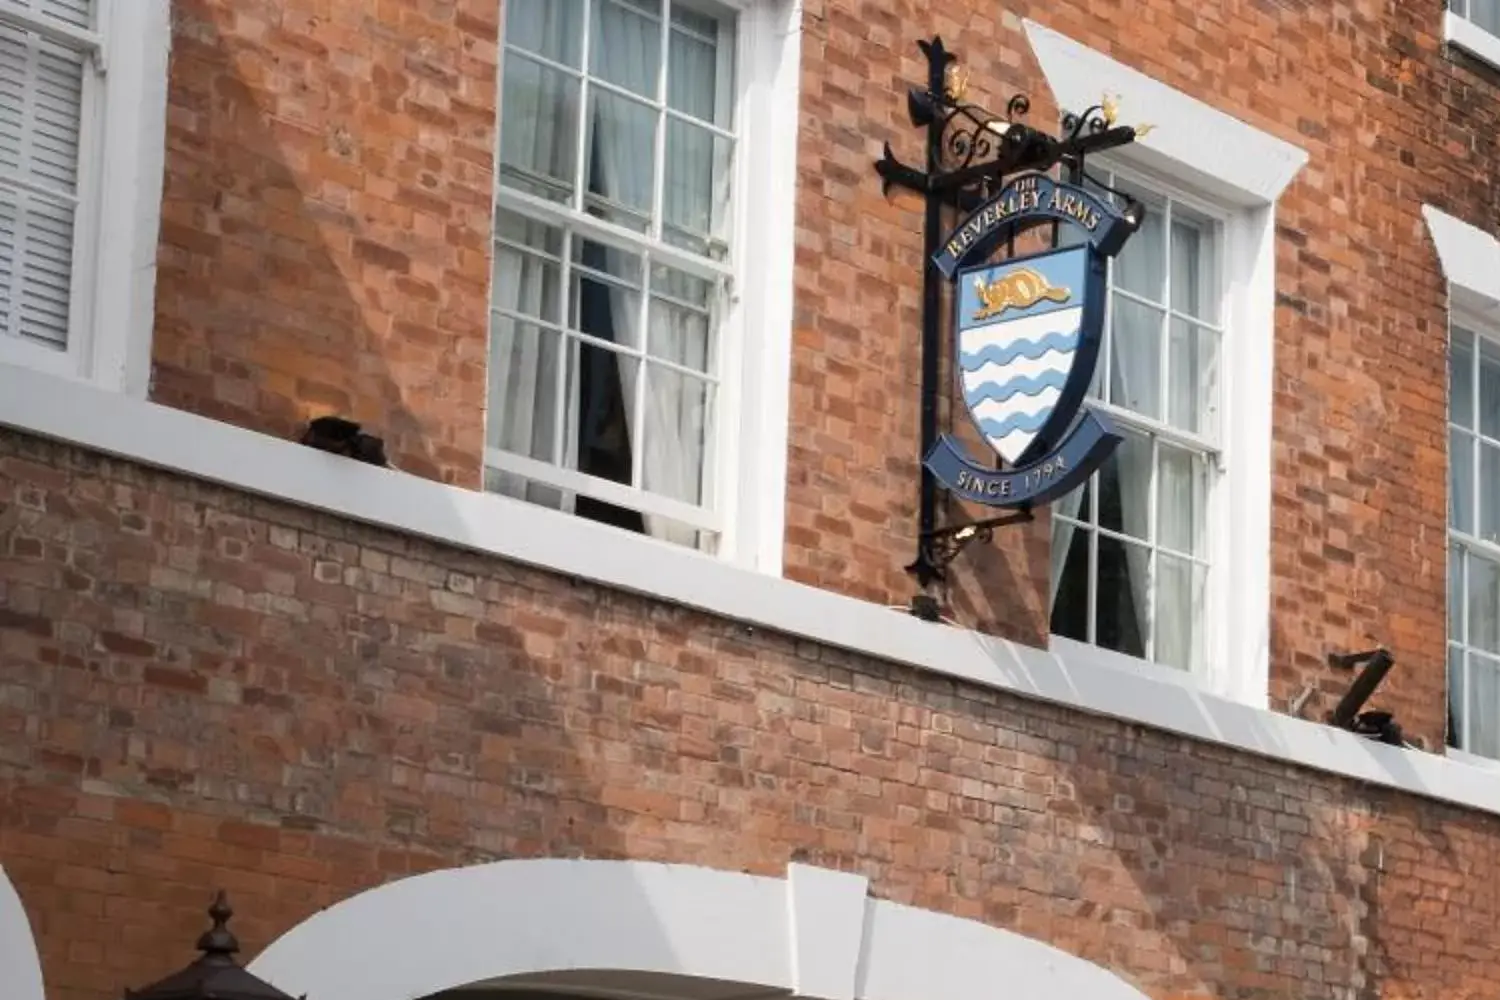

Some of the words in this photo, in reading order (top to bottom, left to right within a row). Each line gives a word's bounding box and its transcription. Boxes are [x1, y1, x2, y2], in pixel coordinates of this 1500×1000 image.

[947, 190, 1046, 259] BEVERLEY
[1048, 189, 1101, 234] ARMS
[956, 470, 1011, 496] SINCE
[1024, 455, 1067, 488] 1794
